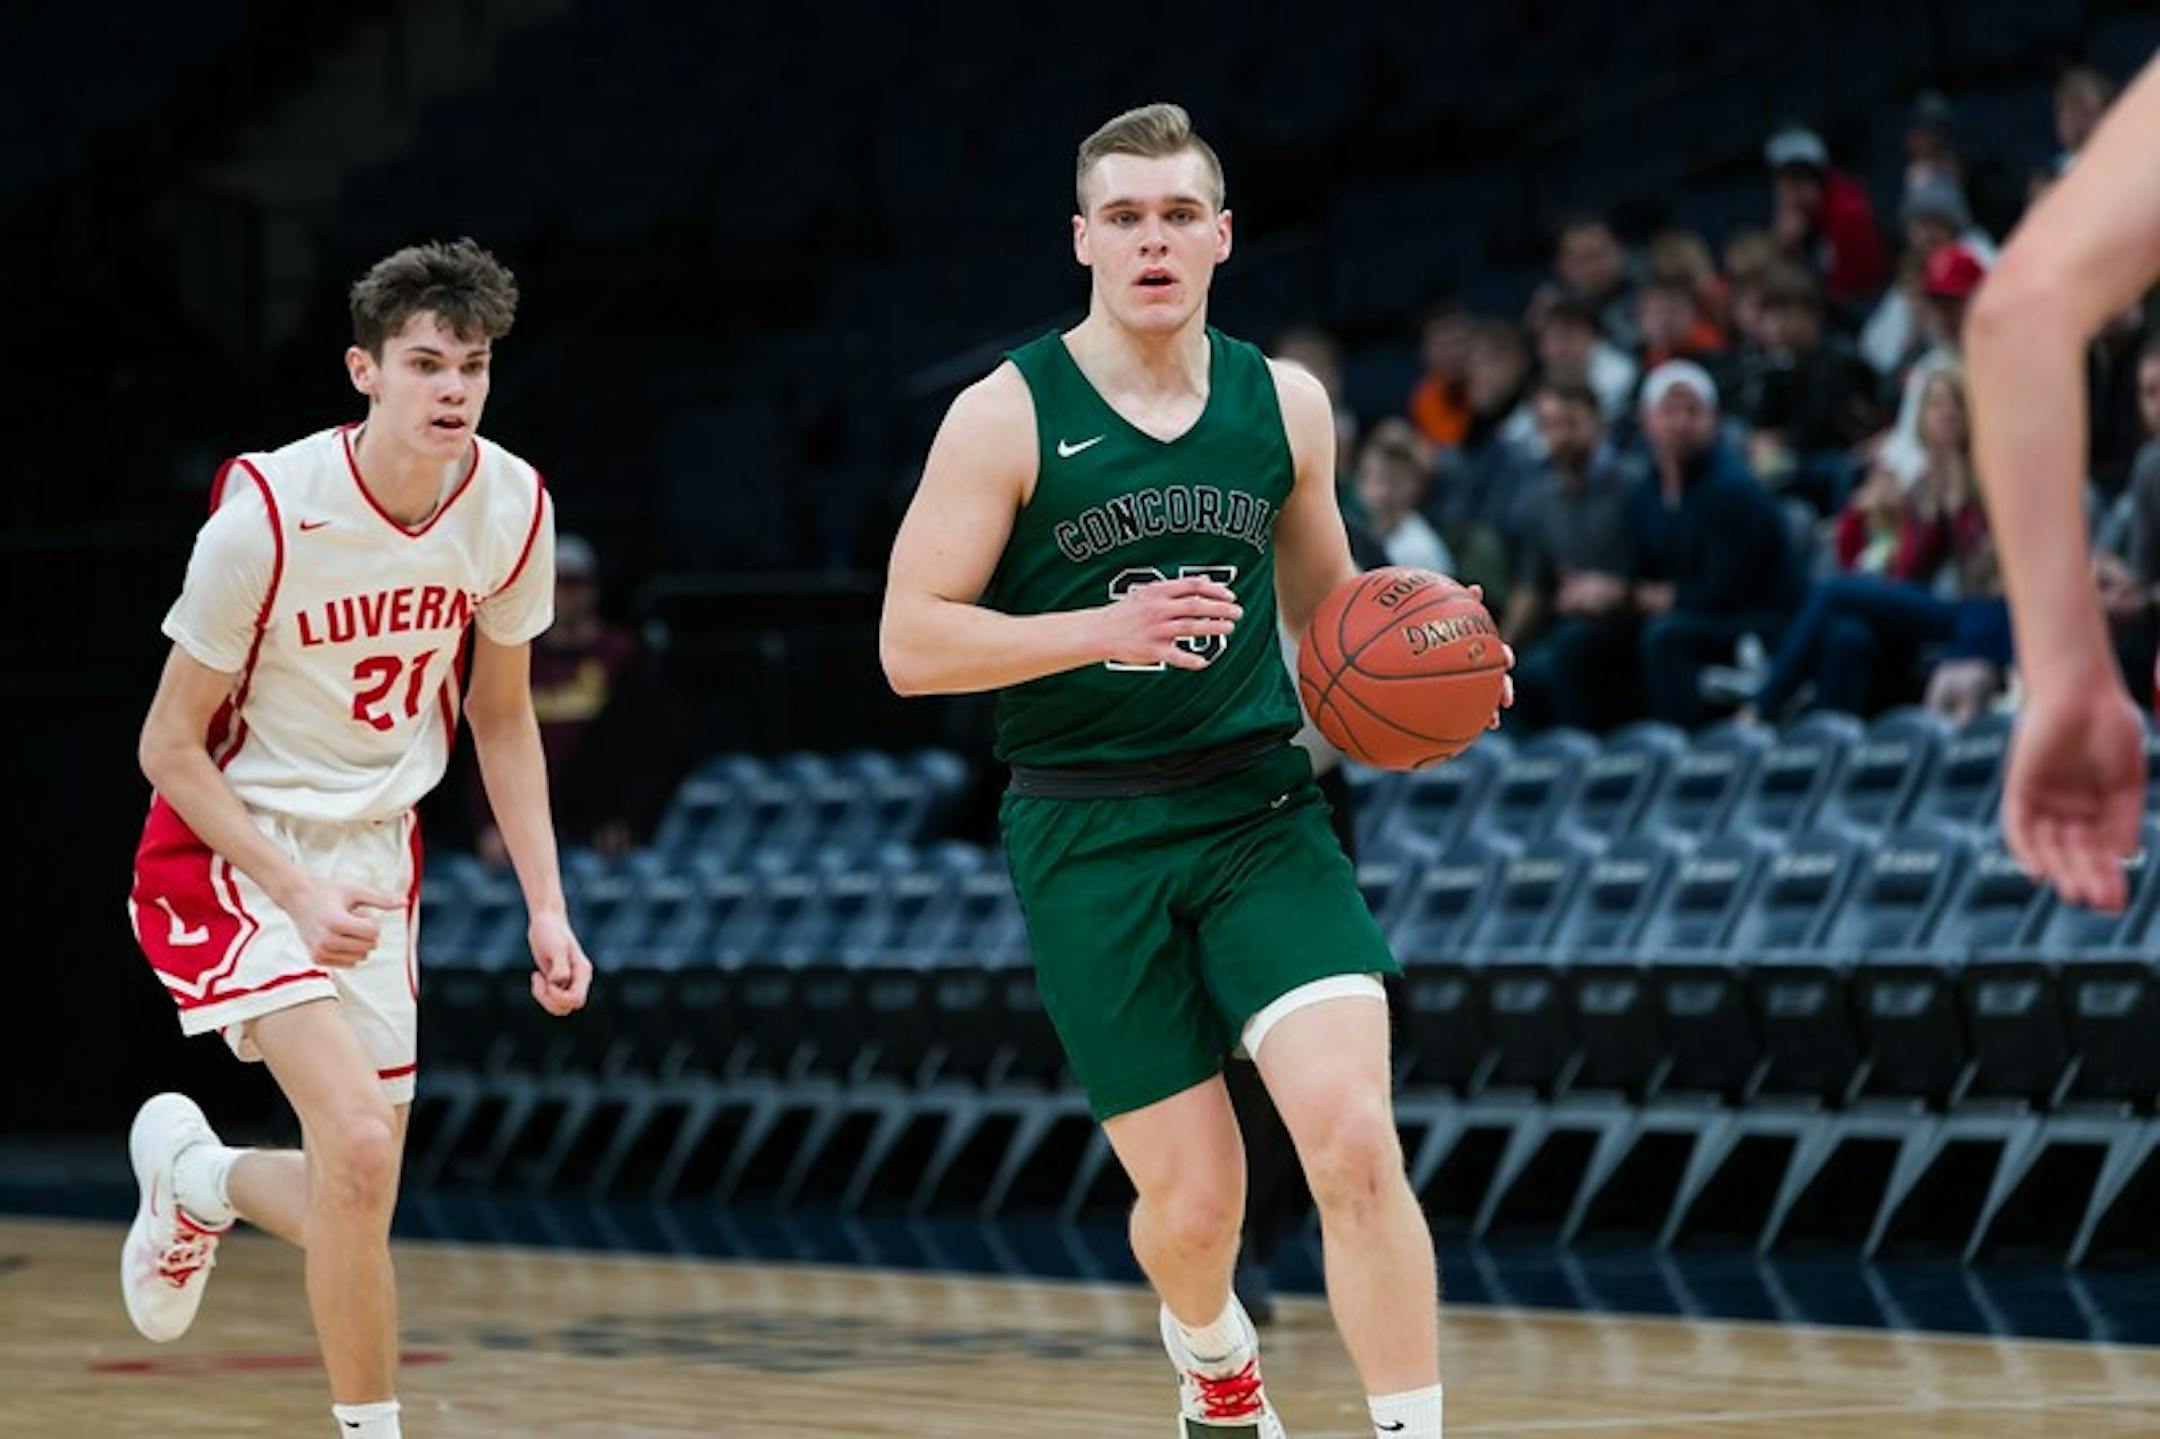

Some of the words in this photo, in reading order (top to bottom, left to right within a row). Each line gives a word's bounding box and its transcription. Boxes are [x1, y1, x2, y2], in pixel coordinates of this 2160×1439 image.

[1054, 485, 1274, 562] CONCORDI
[297, 586, 473, 646] LUVERN
[353, 648, 439, 732] 21
